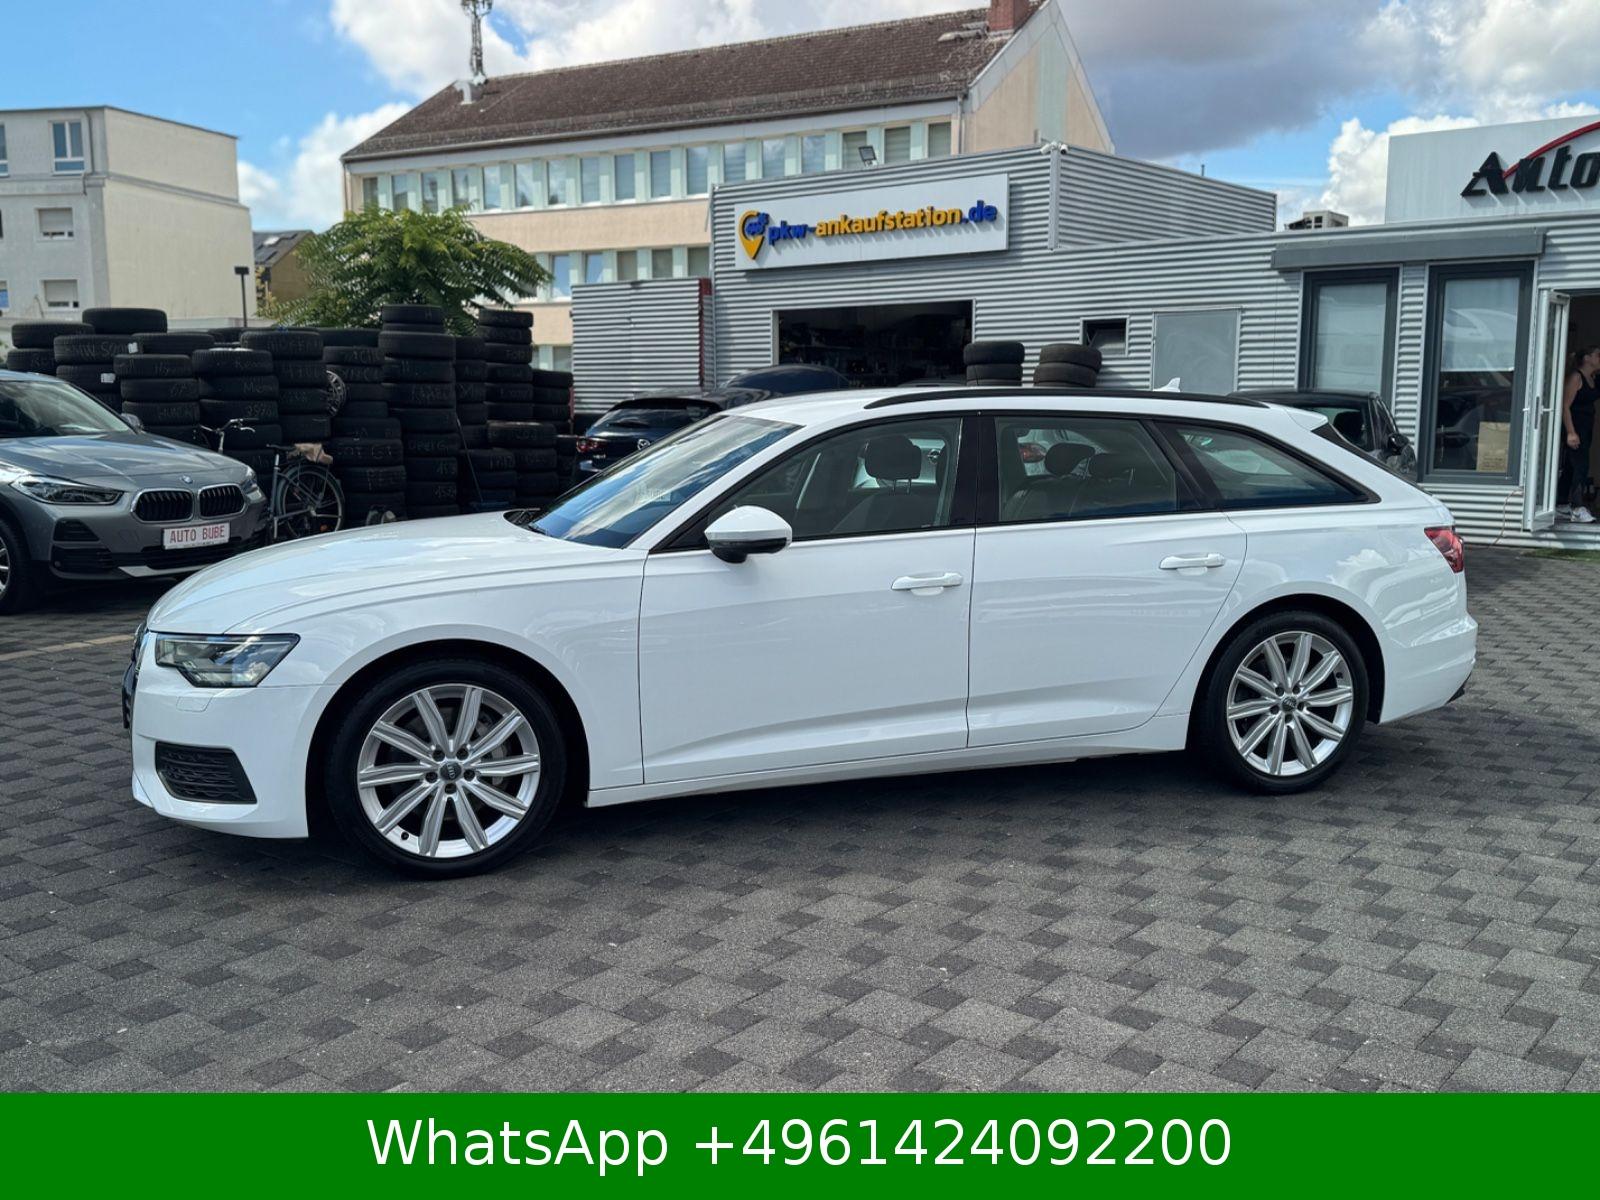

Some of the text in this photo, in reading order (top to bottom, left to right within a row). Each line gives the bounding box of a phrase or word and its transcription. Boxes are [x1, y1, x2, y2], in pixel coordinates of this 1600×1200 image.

[1460, 145, 1600, 197] Auto
[768, 200, 998, 246] pkw-ankaufstation.de
[171, 525, 225, 544] AUTO BUBE
